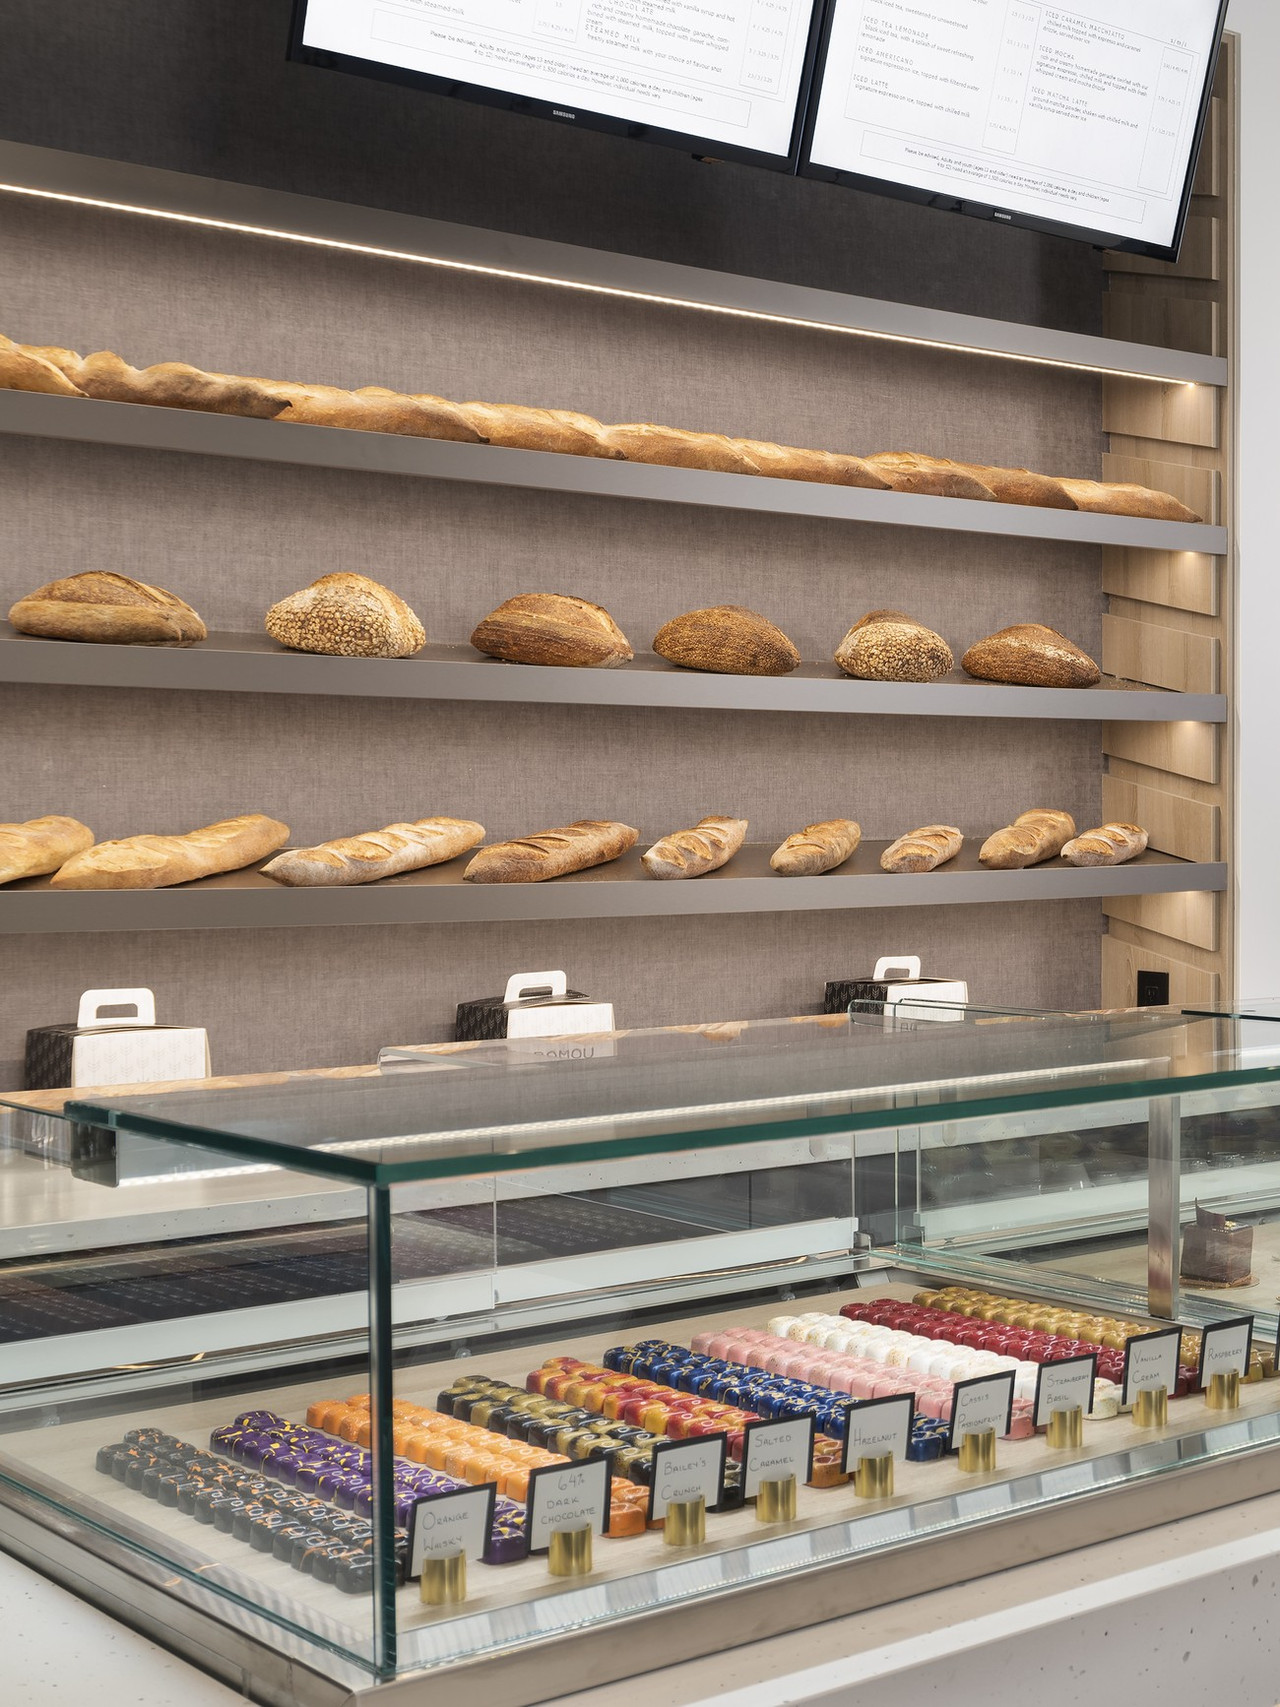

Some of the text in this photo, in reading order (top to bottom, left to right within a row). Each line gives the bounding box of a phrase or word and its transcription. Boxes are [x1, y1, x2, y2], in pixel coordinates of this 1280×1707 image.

[862, 15, 928, 39] ICED TEA LEMONADE
[857, 45, 913, 65] ICED AMERICANO
[853, 73, 888, 89] ICED LATTE
[1133, 1352, 1162, 1364] VANILLA
[1207, 1348, 1243, 1361] RASPBERRY
[1132, 1371, 1160, 1383] CREAM
[961, 1393, 989, 1407] CASSIS
[1046, 1394, 1069, 1404] BASIL
[958, 1413, 1003, 1429] PASSIONFRUIT
[754, 1434, 792, 1448] SALTED
[853, 1428, 898, 1447] HAZELNUT
[663, 1457, 706, 1476] BAILEY'S
[749, 1456, 795, 1472] CARAMEL
[557, 1473, 586, 1491] 64%
[661, 1484, 701, 1500] CRUNCH
[547, 1497, 580, 1510] DARK
[422, 1511, 470, 1531] ORANGE
[540, 1507, 596, 1525] CHOCOLATE
[423, 1535, 463, 1551] WHISKY
